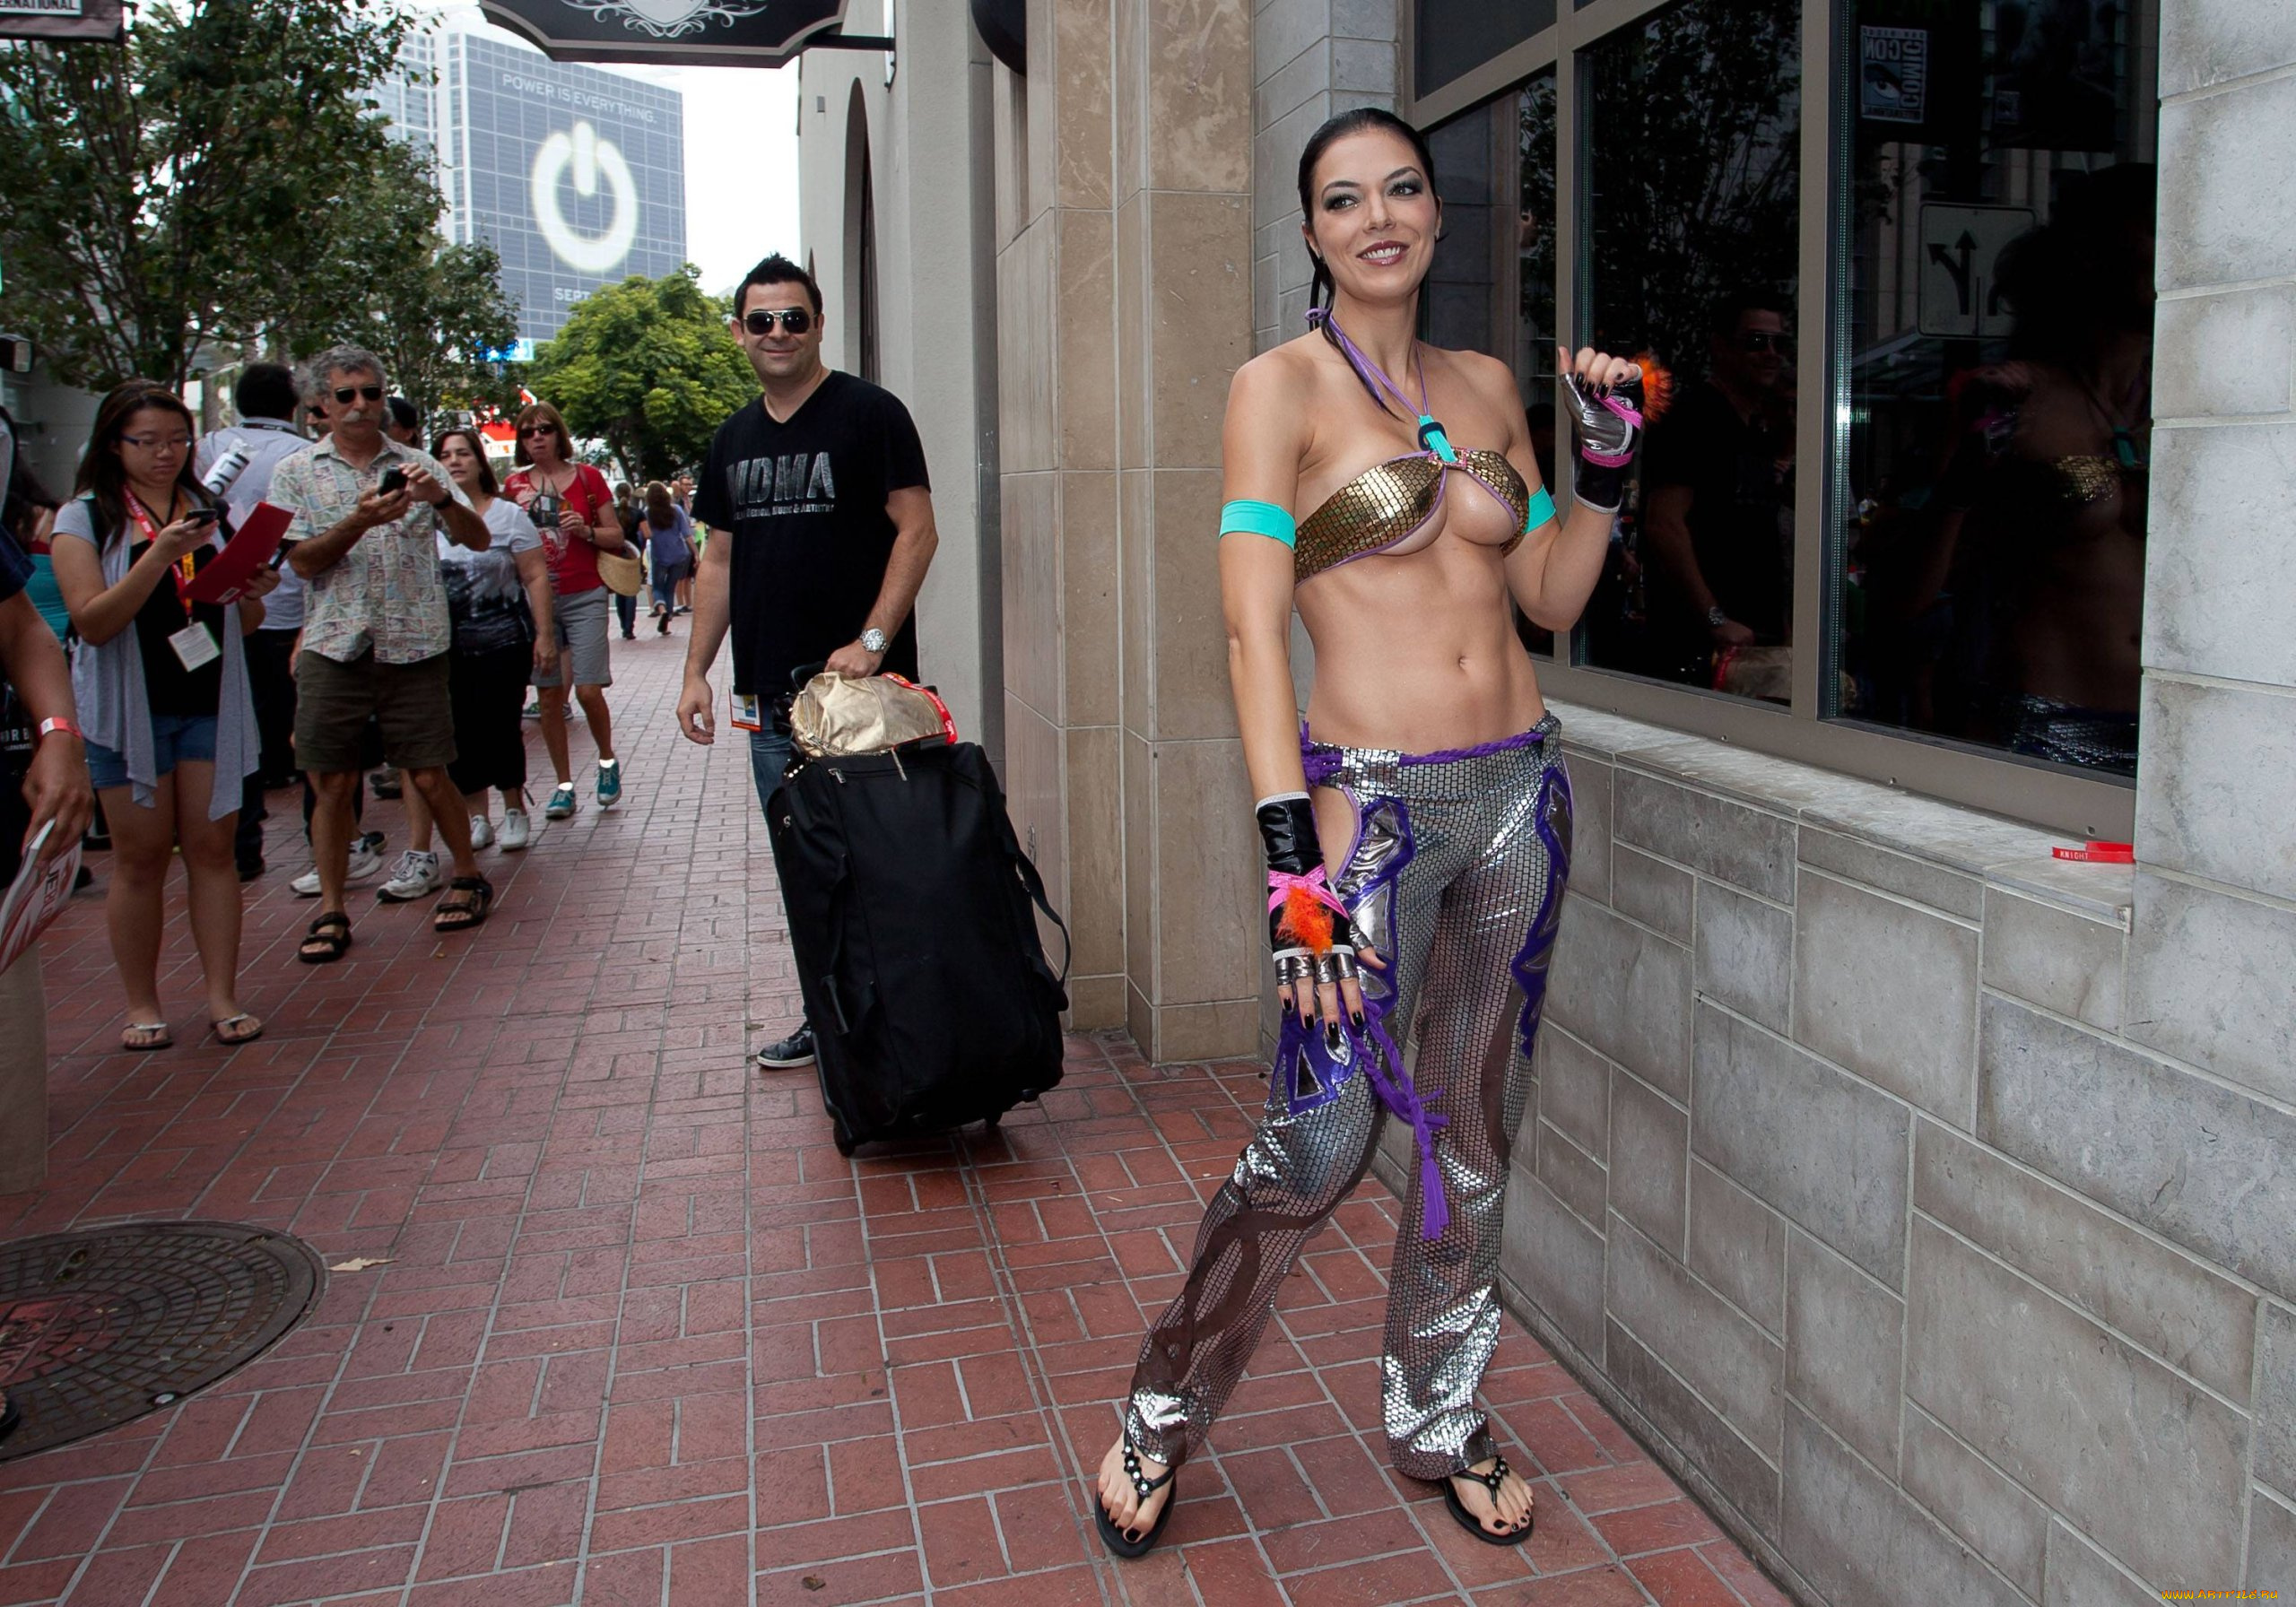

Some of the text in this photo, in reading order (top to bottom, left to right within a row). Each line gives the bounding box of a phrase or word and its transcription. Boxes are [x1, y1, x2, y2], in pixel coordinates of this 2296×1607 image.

[502, 74, 657, 124] POWER IS EVERYTHING.
[2059, 850, 2089, 860] KNIGHT
